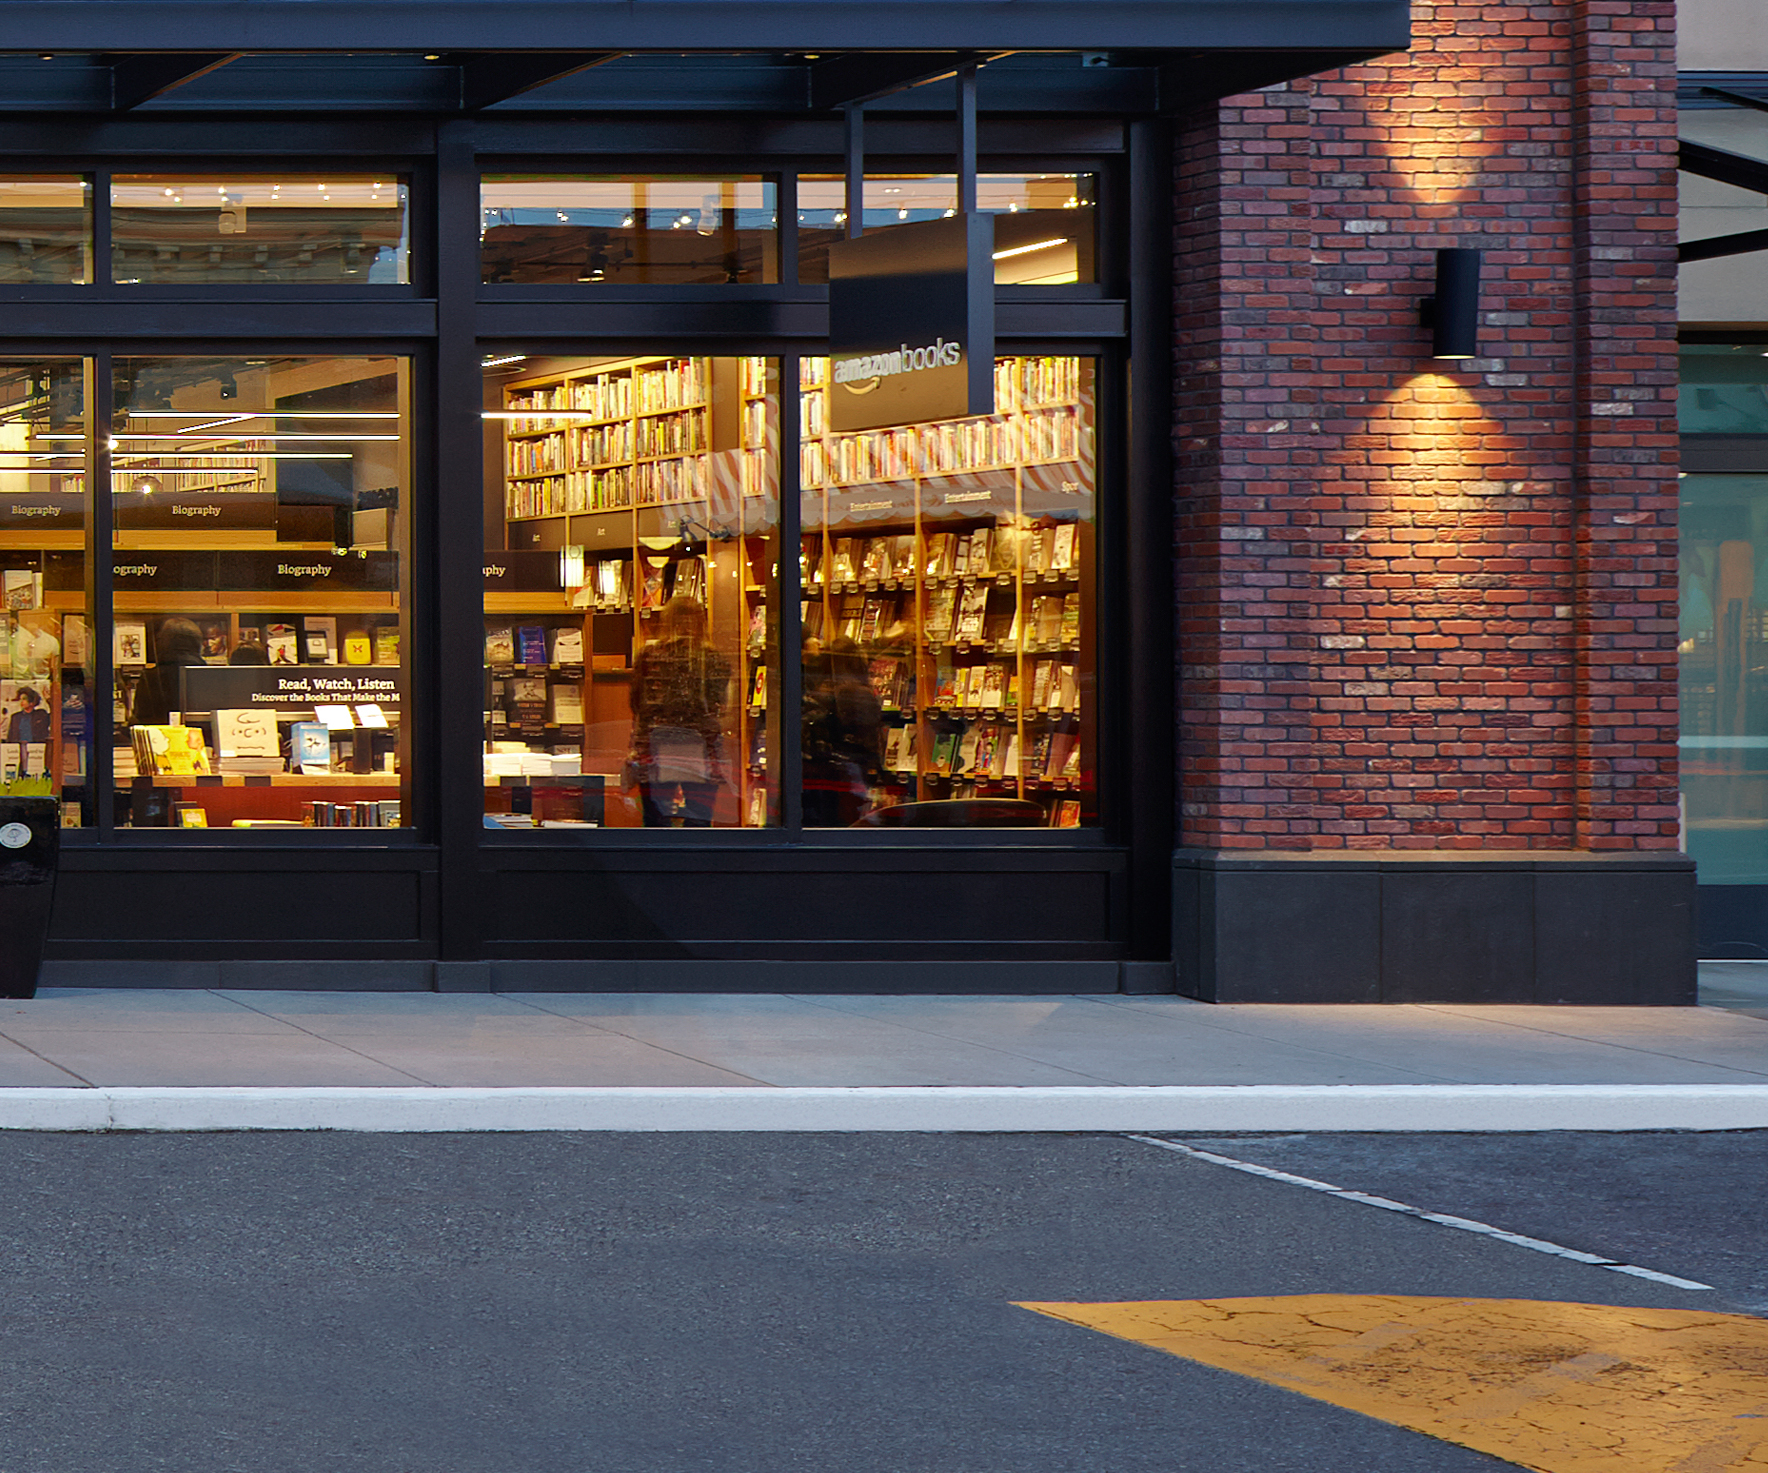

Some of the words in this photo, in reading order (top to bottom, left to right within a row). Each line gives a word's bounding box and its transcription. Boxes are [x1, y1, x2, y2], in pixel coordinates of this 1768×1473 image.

[834, 337, 961, 384] amazonbooks
[11, 504, 61, 517] Biography
[172, 504, 221, 517] Biography
[277, 564, 332, 577] Biography
[278, 678, 312, 691] Read,
[312, 678, 356, 692] Watch,
[357, 678, 395, 690] Listen
[251, 693, 289, 702] Discover
[289, 693, 304, 702] the
[305, 693, 330, 702] Books
[331, 693, 352, 702] That
[352, 693, 375, 702] Make
[376, 693, 390, 702] the
